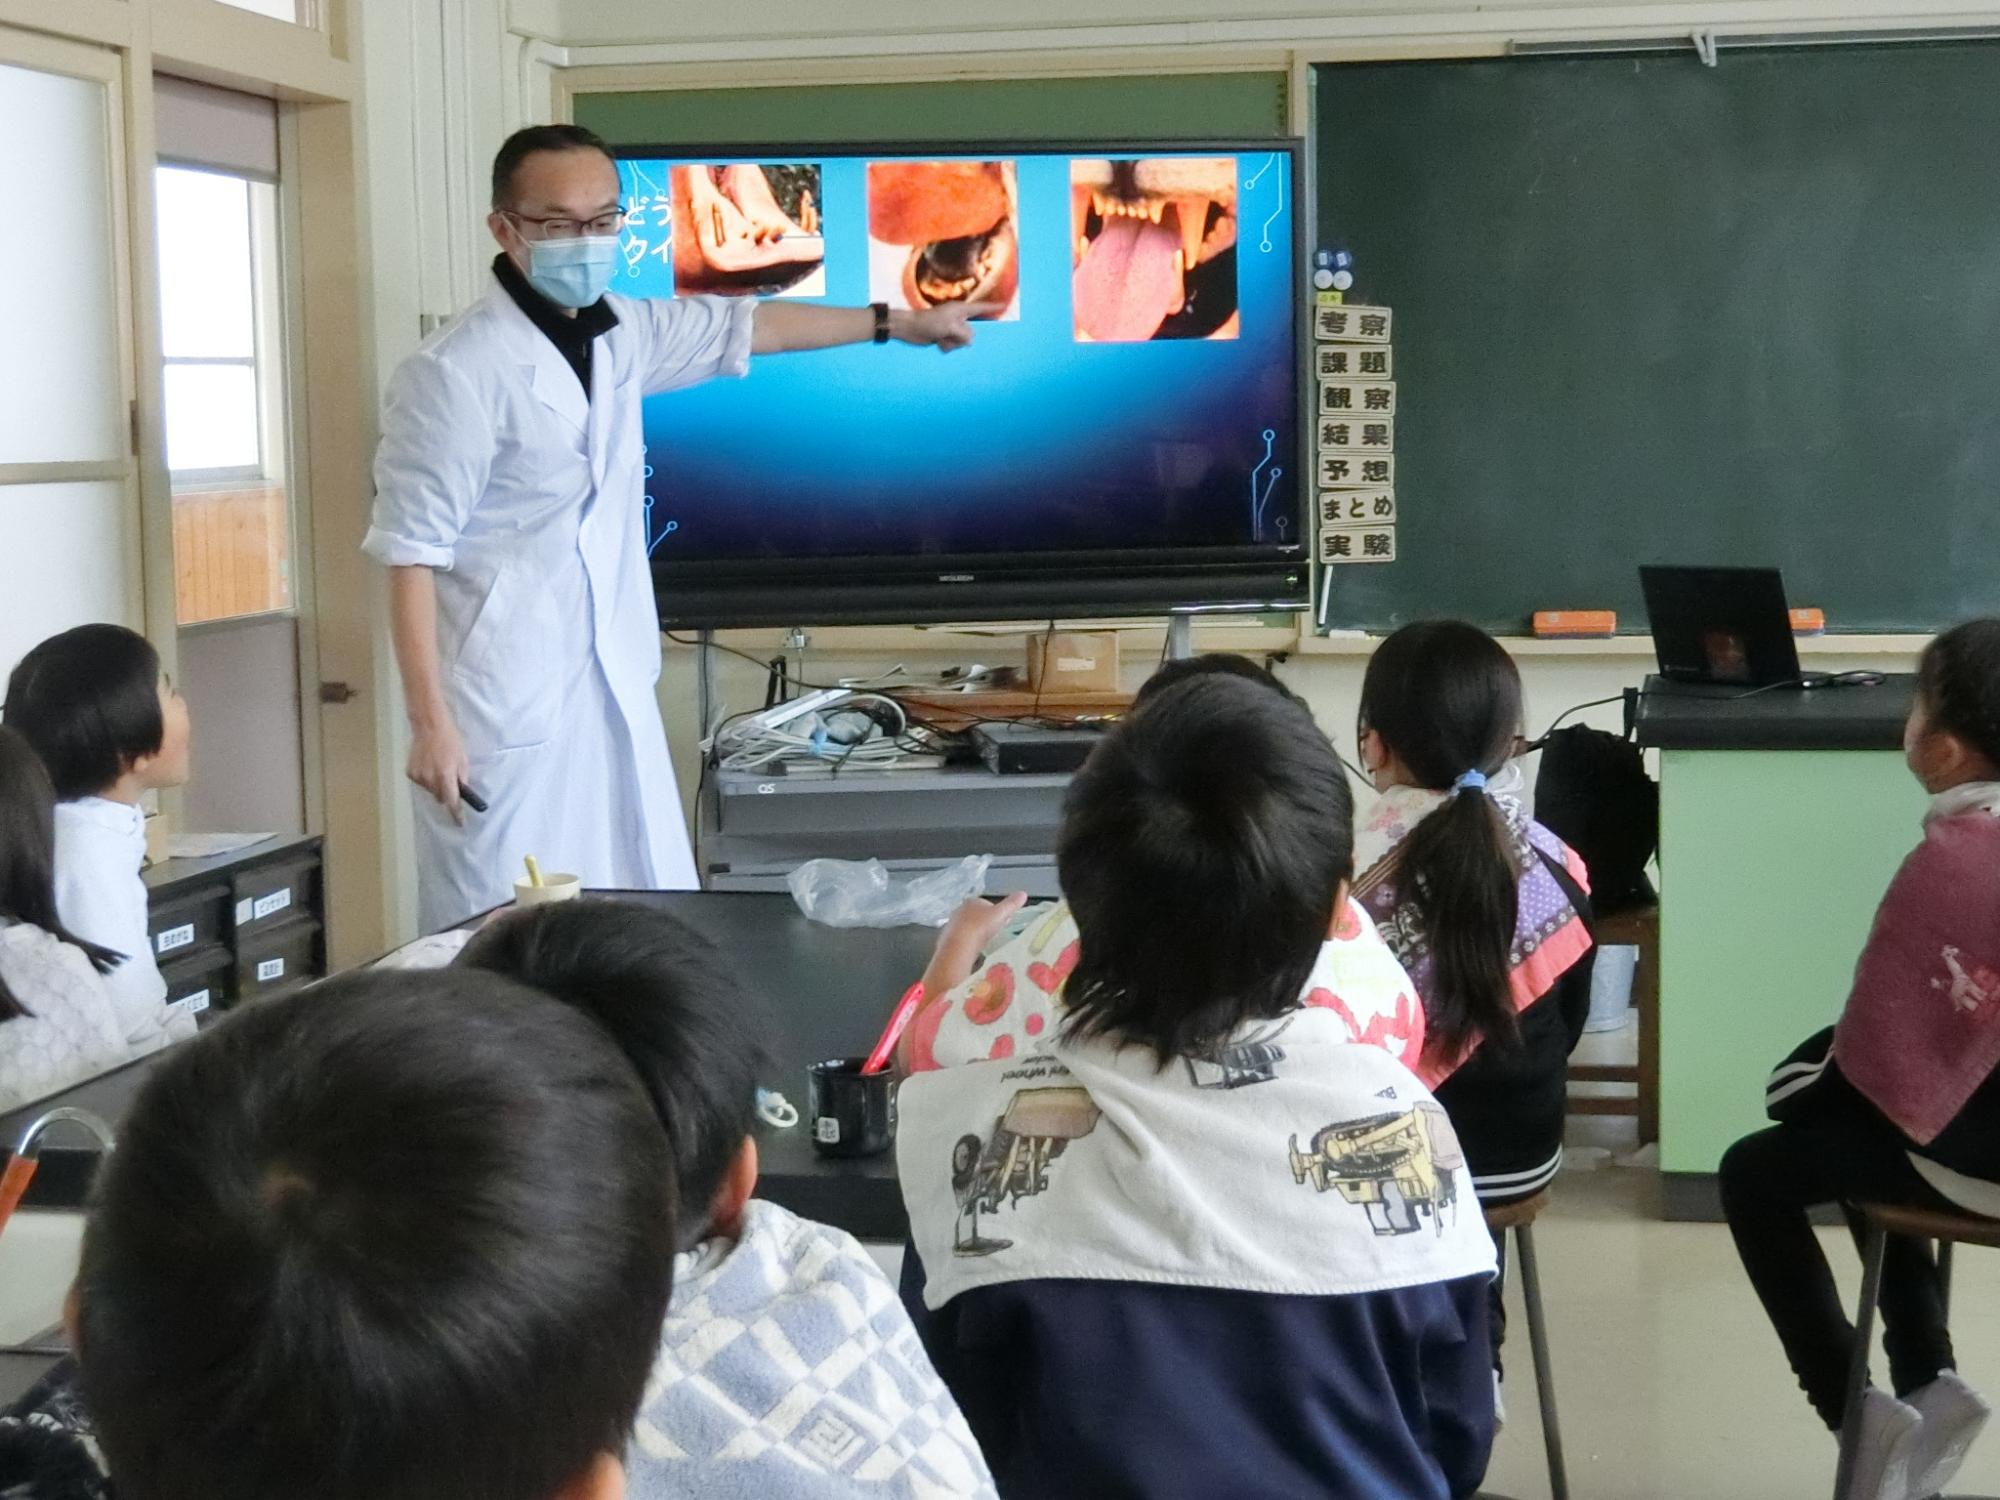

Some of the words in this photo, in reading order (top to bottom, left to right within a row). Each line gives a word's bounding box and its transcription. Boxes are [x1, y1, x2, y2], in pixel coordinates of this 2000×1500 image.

[1320, 311, 1386, 336] 考察
[1321, 350, 1386, 374] 課題
[1324, 387, 1390, 411] 観察
[1323, 422, 1388, 446] 結果
[1323, 459, 1388, 483] 予想
[1324, 497, 1392, 520] まとめ
[1325, 533, 1391, 557] 実験
